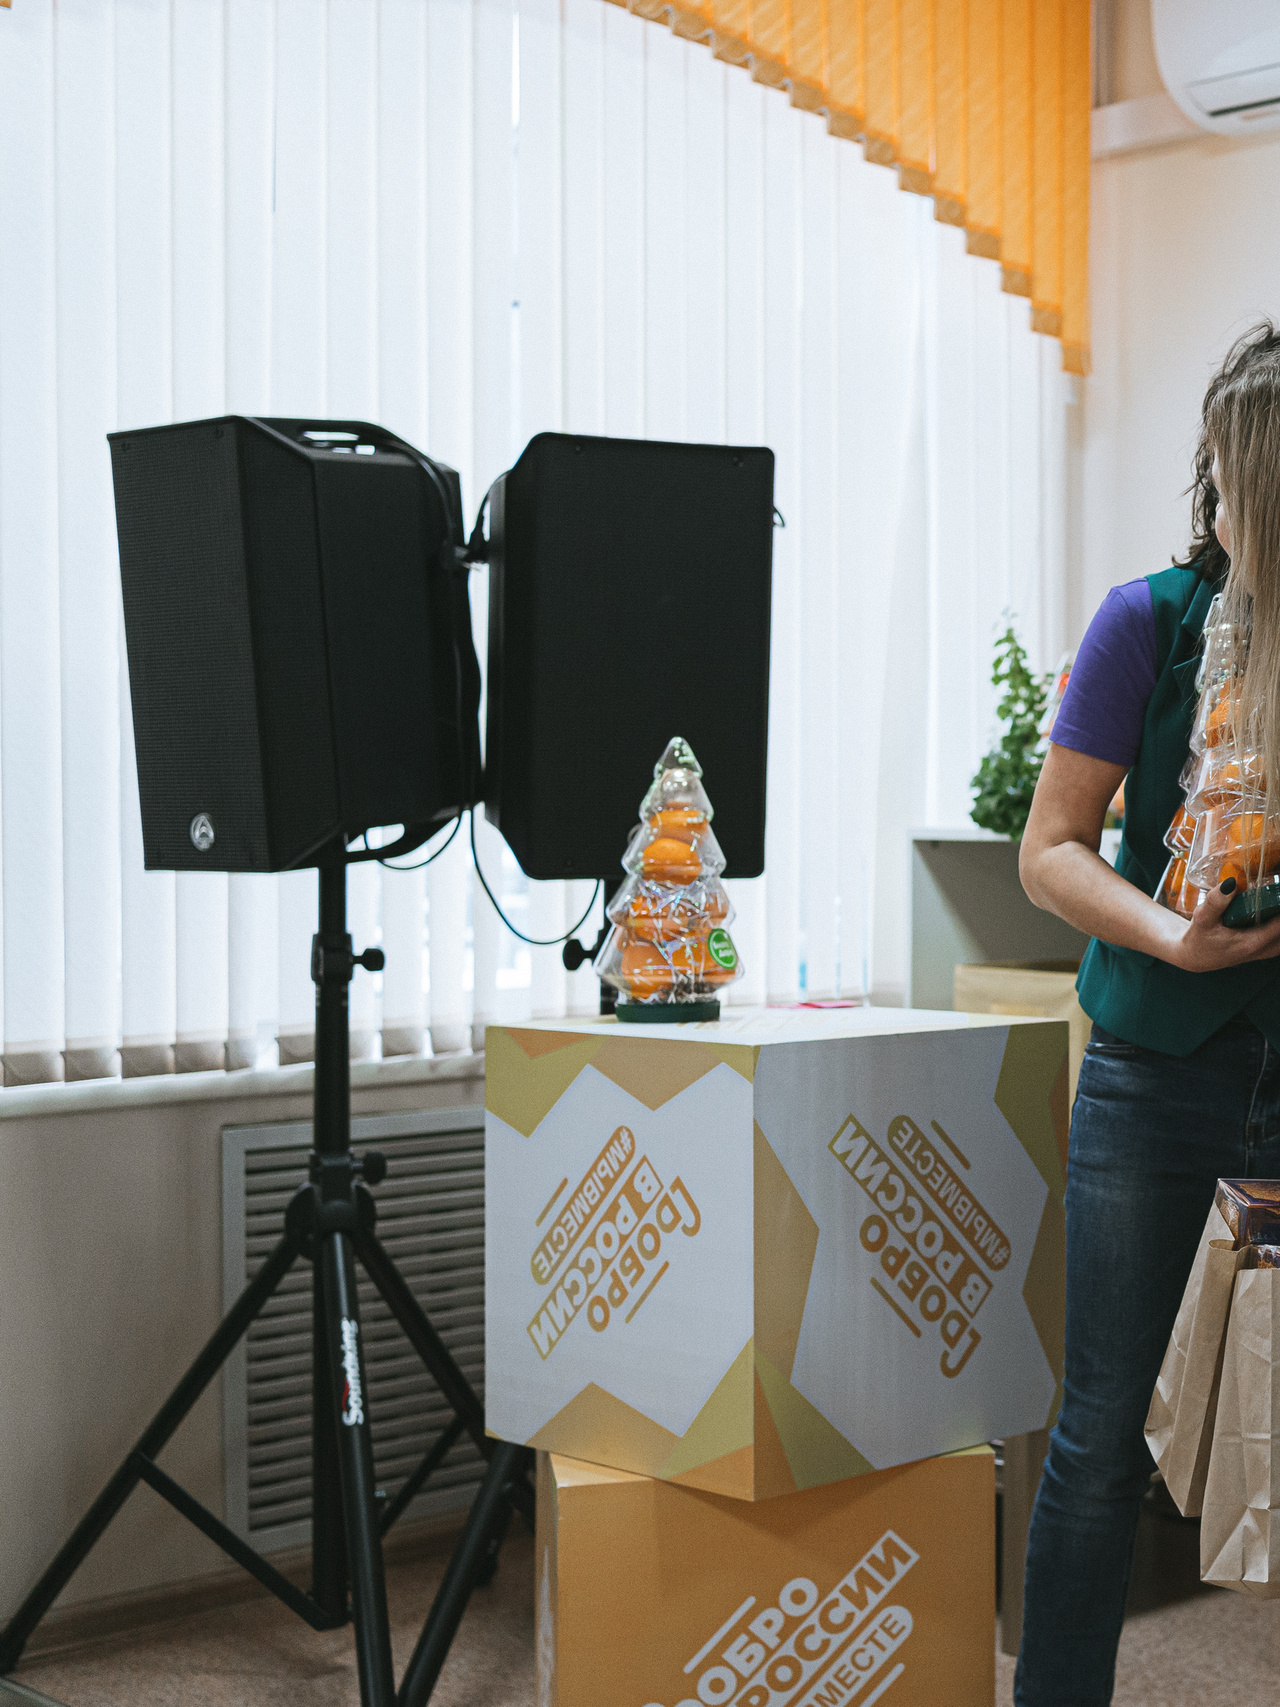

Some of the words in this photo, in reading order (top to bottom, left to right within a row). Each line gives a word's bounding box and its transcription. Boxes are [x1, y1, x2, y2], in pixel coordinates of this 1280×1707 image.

[632, 1161, 661, 1203] В
[832, 1121, 964, 1284] РОССИИ
[530, 1194, 639, 1352] РОССИИ
[959, 1273, 989, 1314] В
